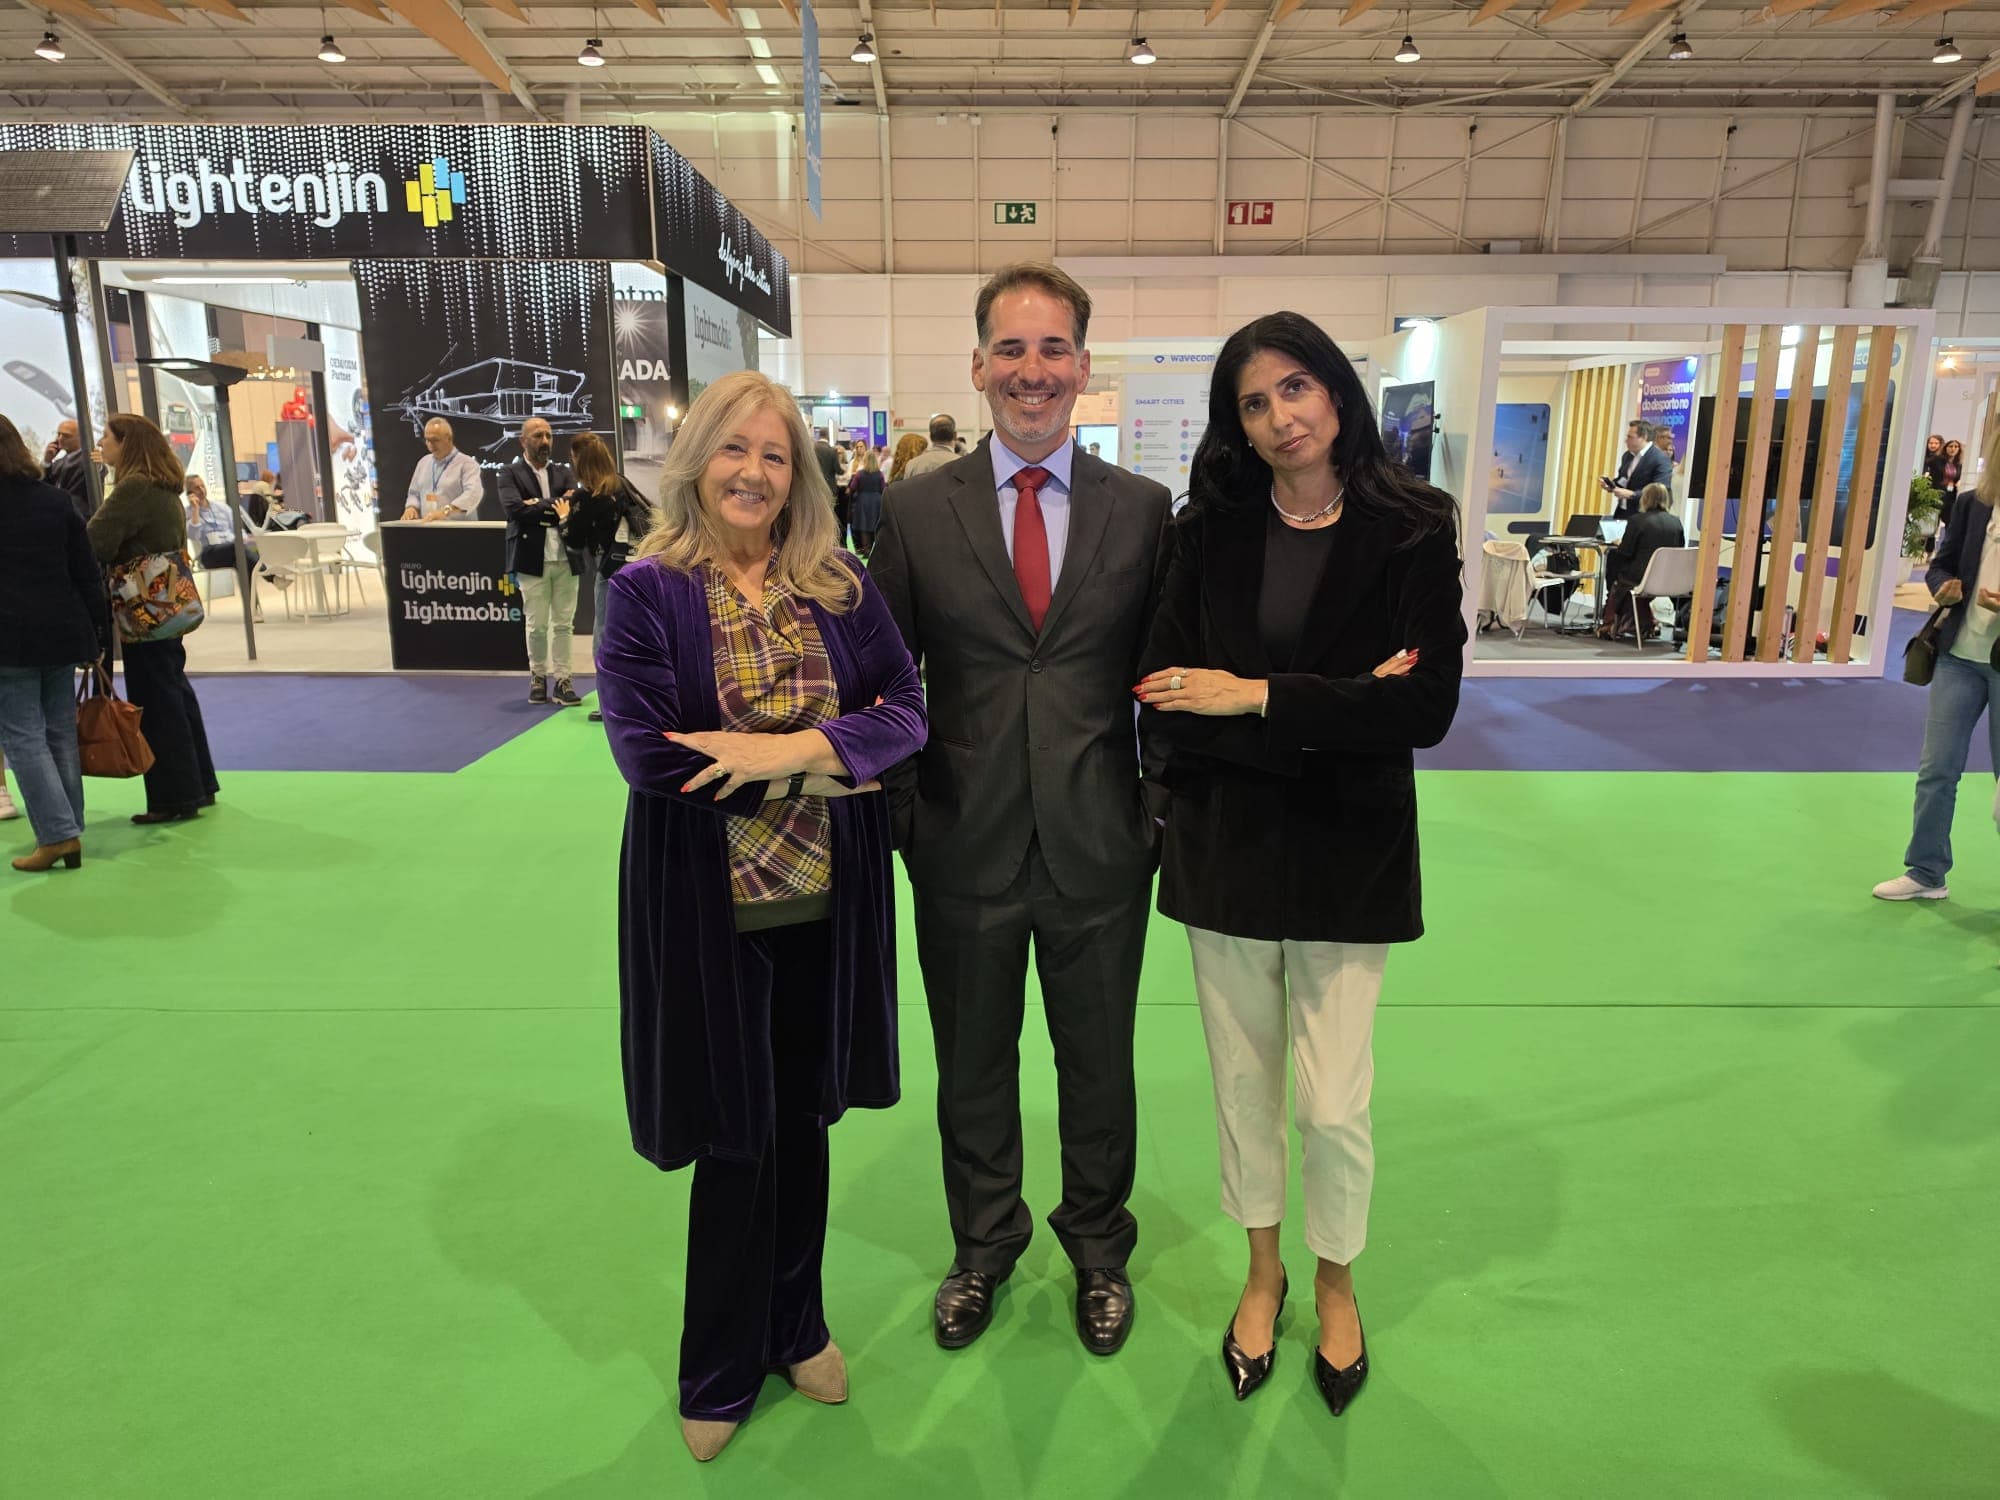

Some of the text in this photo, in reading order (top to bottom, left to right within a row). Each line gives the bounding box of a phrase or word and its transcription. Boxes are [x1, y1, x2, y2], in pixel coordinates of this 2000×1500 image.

[1135, 398, 1185, 406] SMART CITIES
[1651, 397, 1679, 413] desporto
[1679, 398, 1689, 410] no
[403, 600, 521, 625] lightmobie
